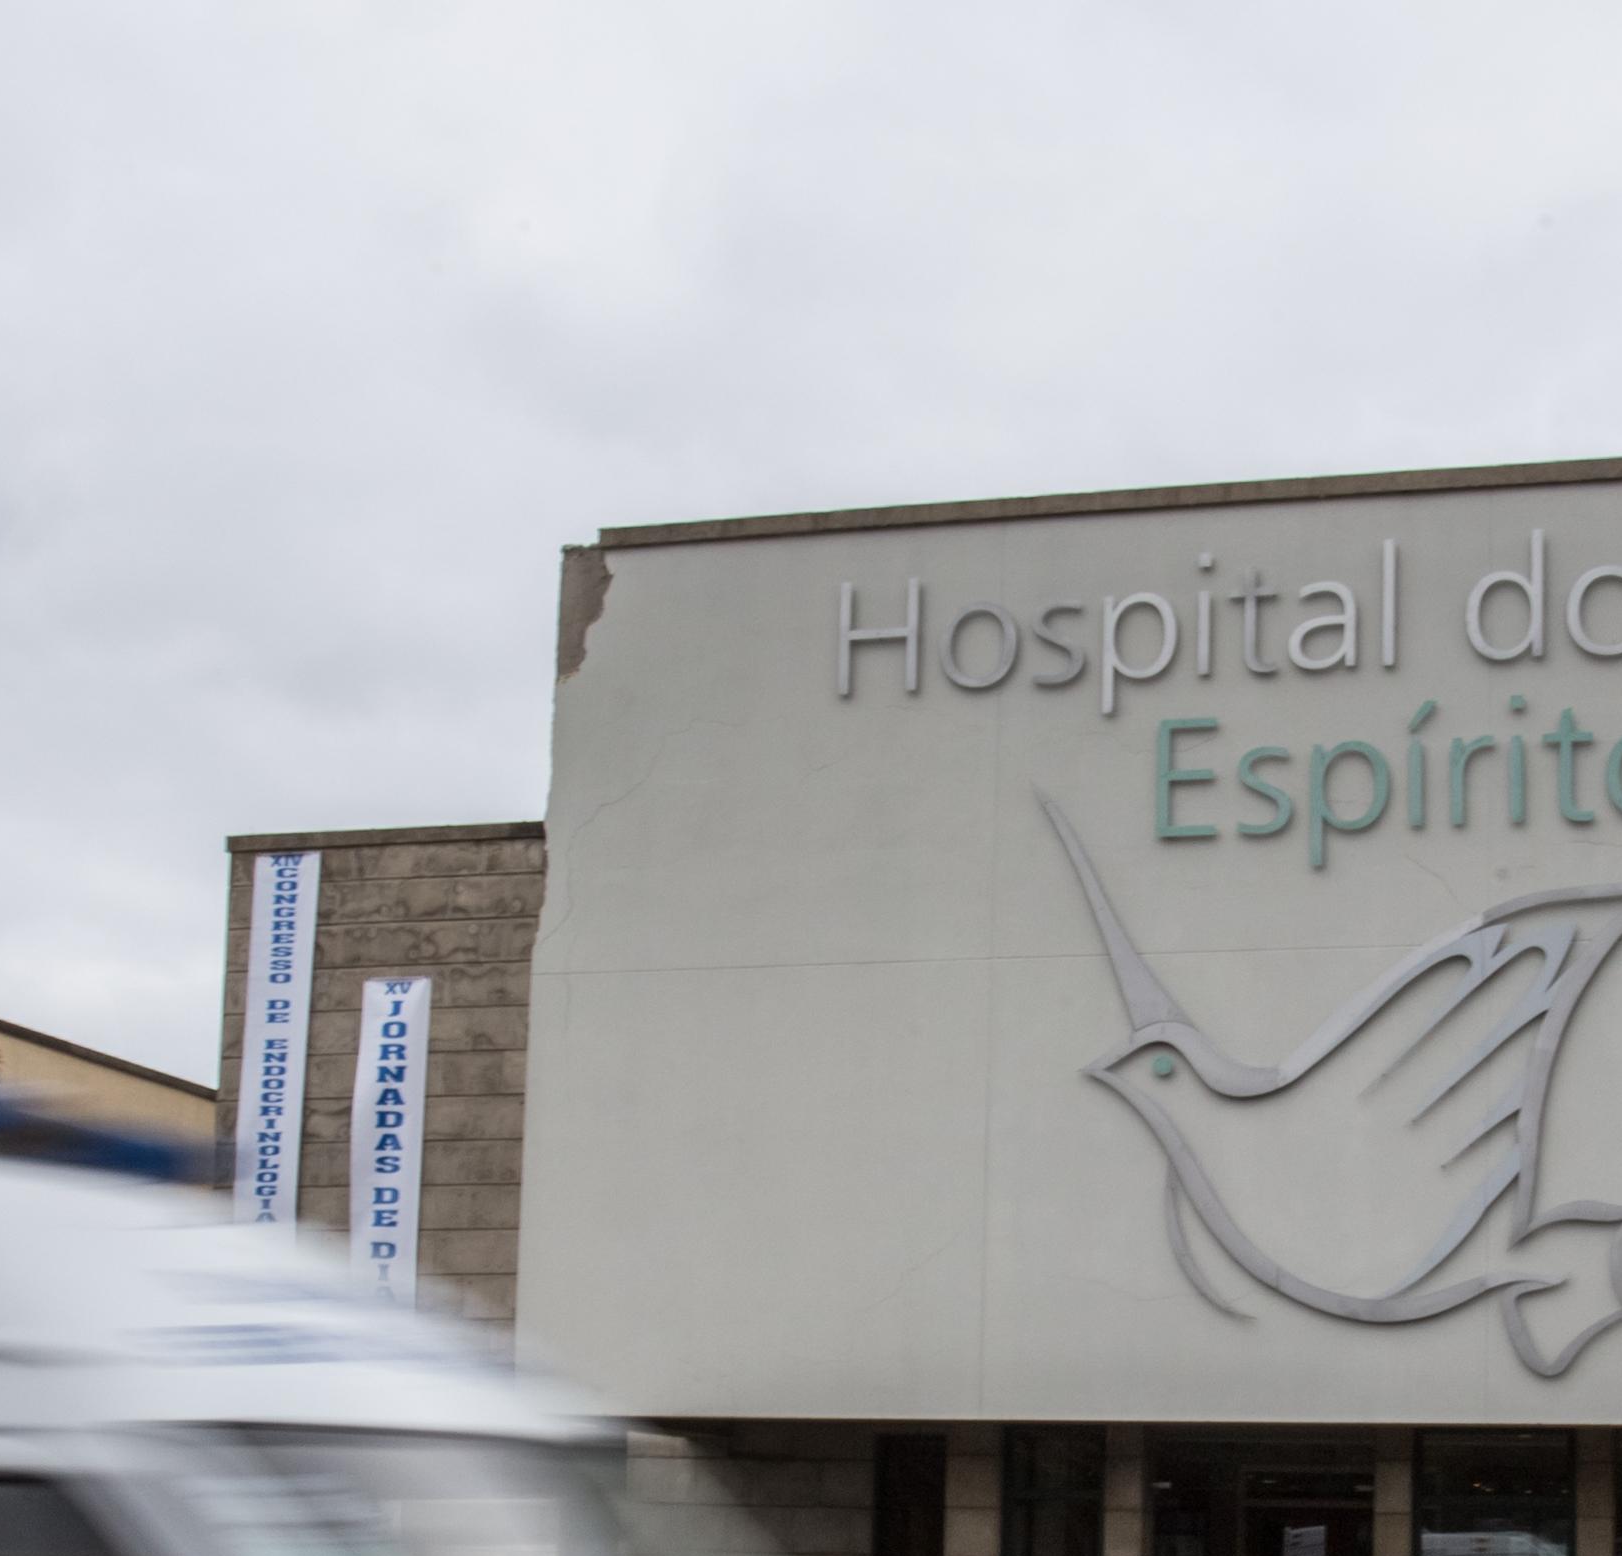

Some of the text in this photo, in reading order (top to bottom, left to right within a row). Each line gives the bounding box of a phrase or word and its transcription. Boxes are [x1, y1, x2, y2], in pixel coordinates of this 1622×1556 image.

[834, 538, 1398, 716] Hospital
[255, 867, 299, 1223] CONGRESSO DE ENDOCRINOLOGIA
[384, 981, 413, 995] XV
[374, 1000, 407, 1174] JORNADAS
[372, 1186, 399, 1227] DE
